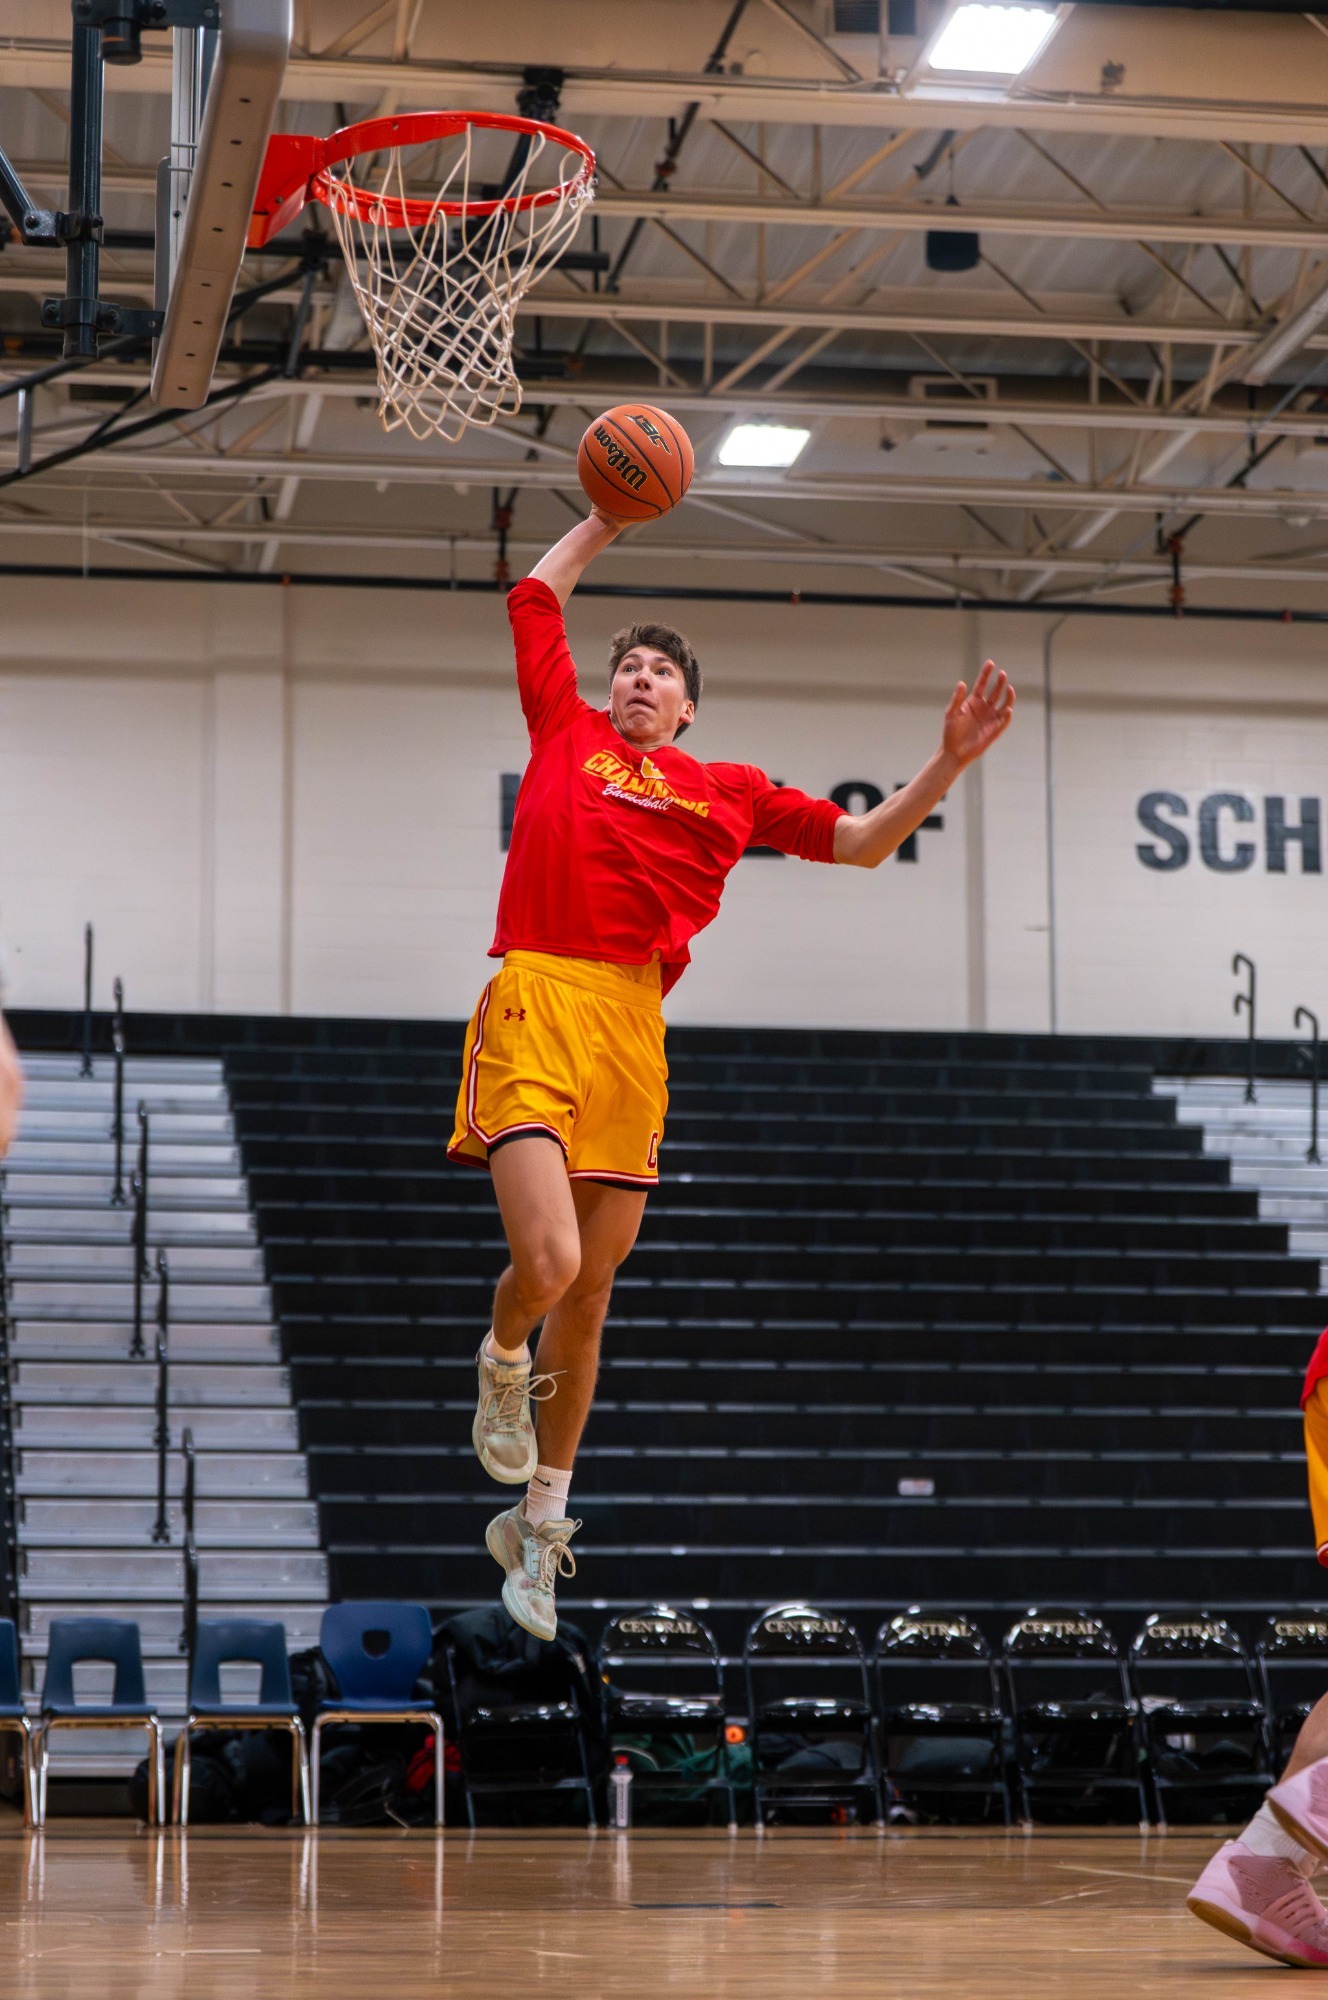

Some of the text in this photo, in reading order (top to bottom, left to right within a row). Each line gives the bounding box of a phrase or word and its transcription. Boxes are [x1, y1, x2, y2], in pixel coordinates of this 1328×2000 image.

[593, 424, 647, 492] Wilson
[624, 414, 672, 455] JET
[1136, 791, 1322, 873] SCH
